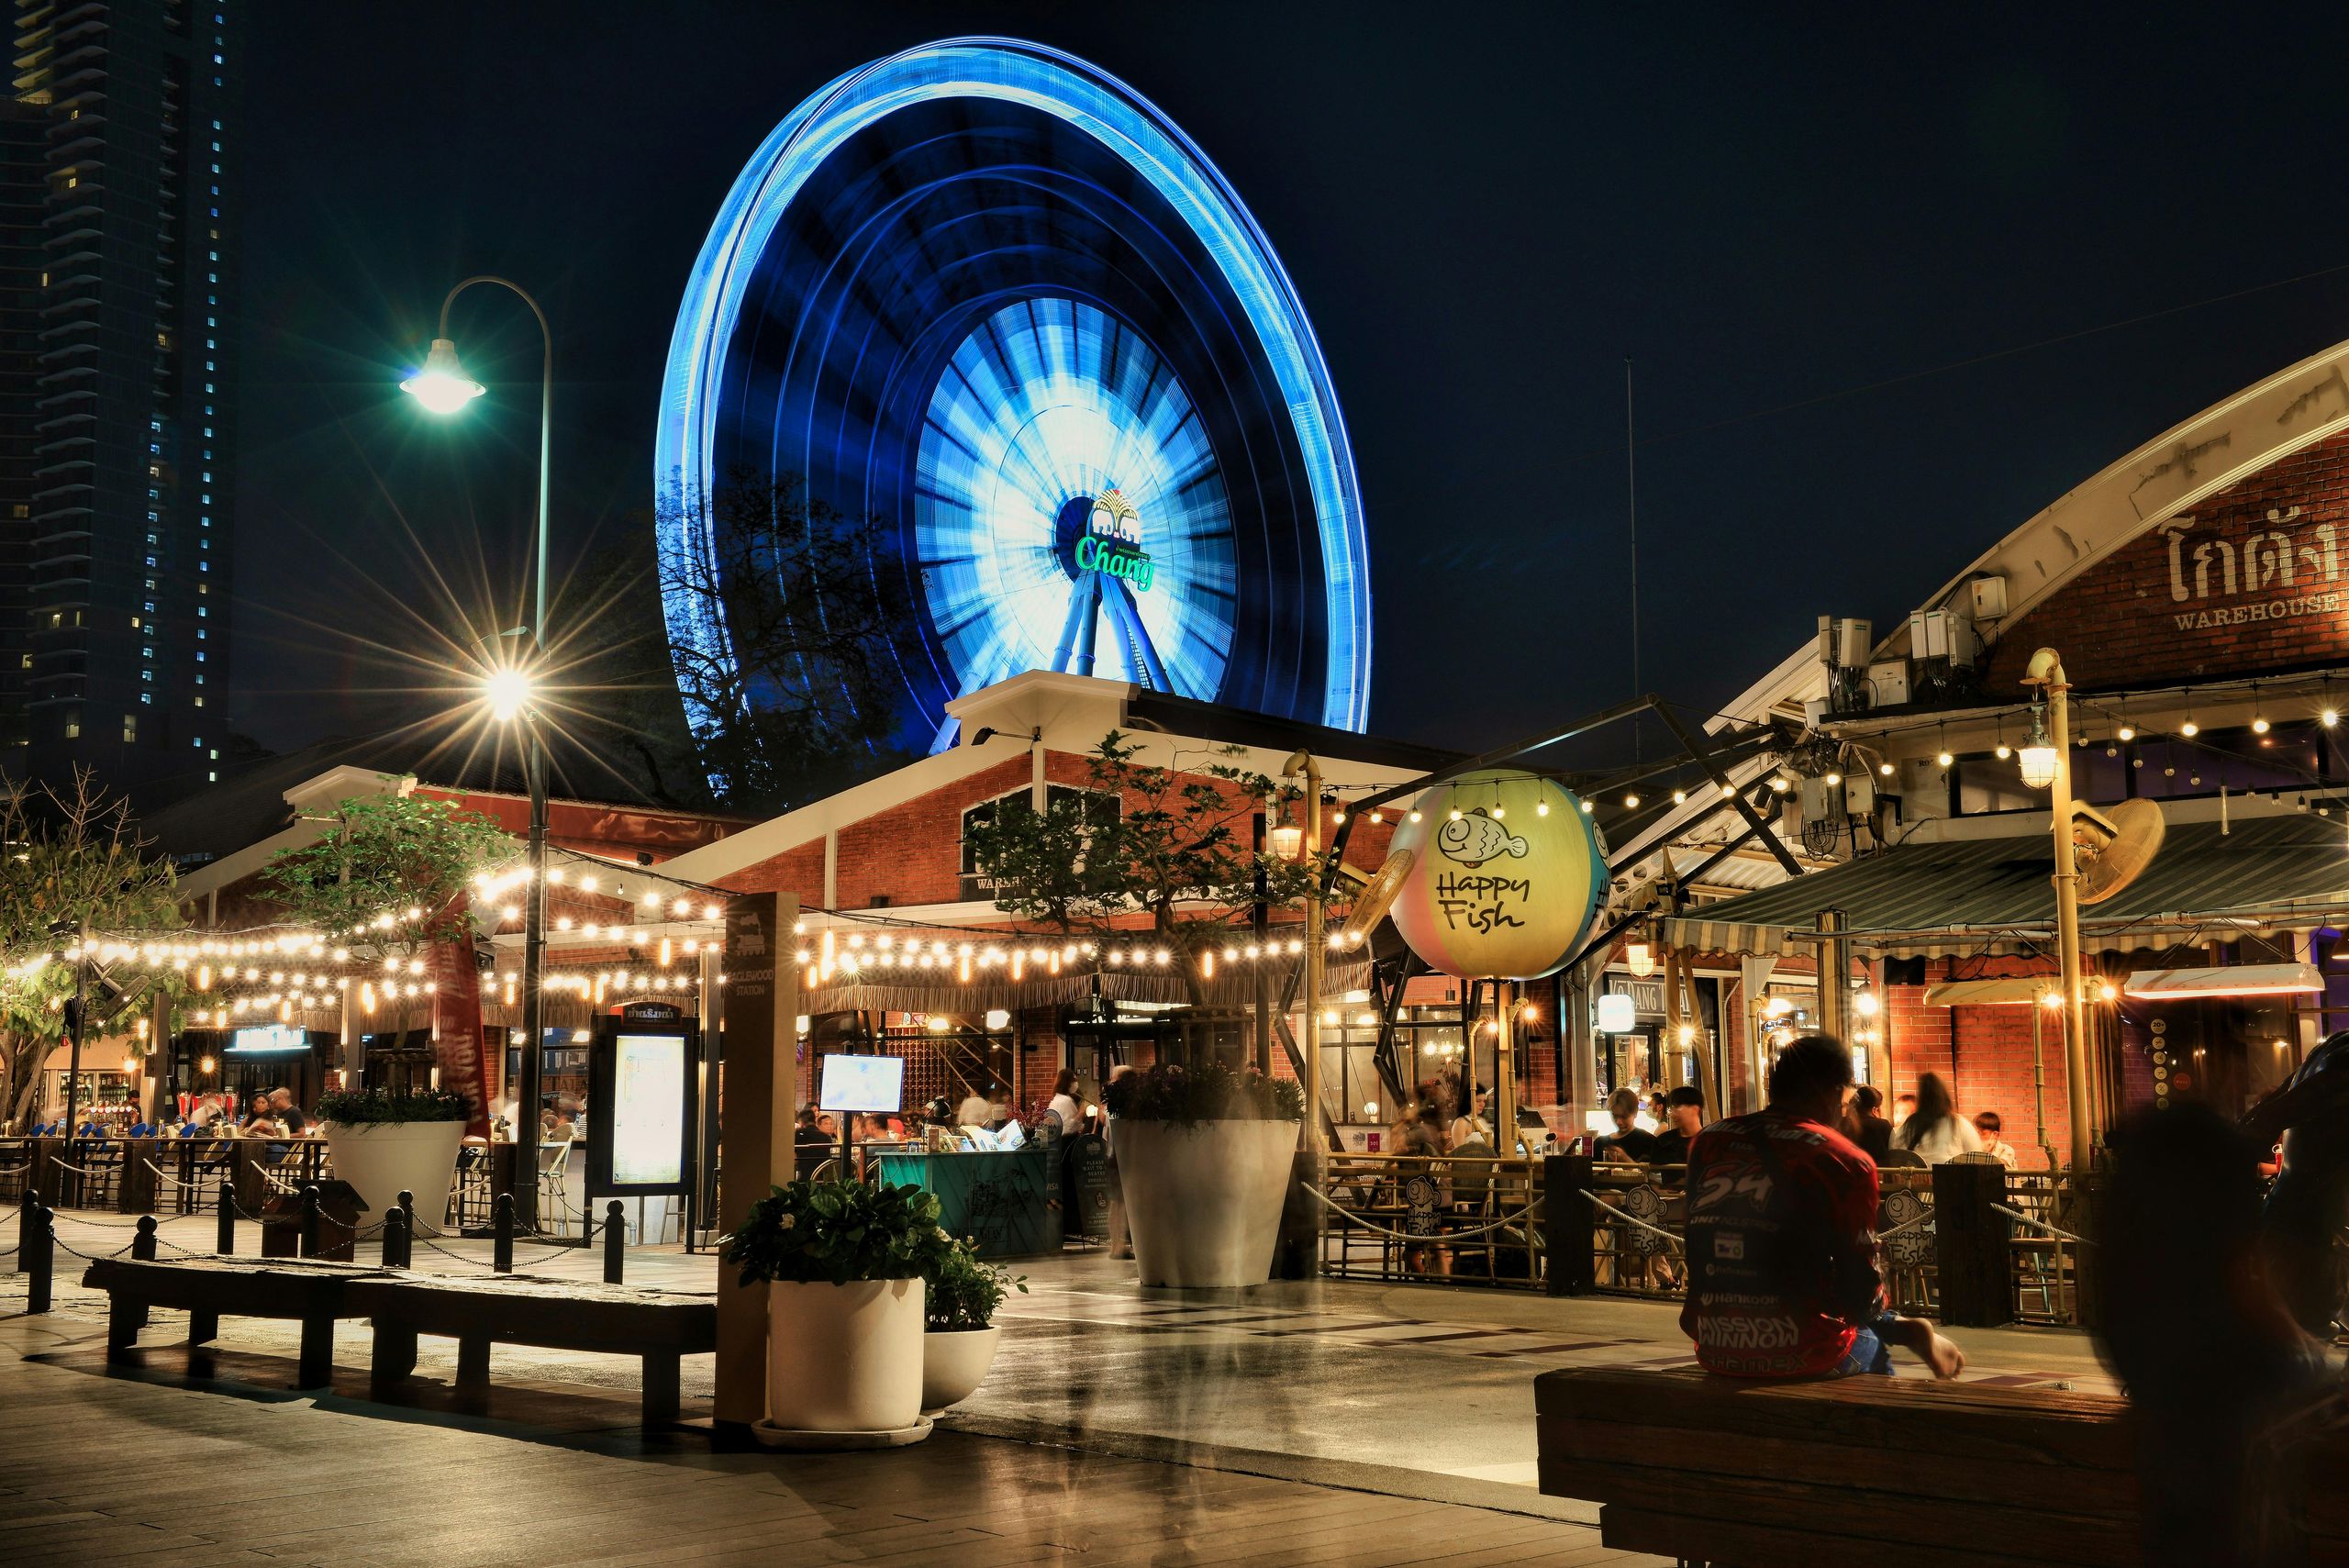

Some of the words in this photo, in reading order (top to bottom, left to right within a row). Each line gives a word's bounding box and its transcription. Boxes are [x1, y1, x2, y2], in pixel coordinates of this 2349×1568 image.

[1075, 536, 1155, 592] Chang
[2157, 506, 2339, 602] โกดัง
[2173, 594, 2341, 632] WAREHOUSE
[1436, 871, 1531, 902] Happy
[1438, 900, 1526, 935] Fish
[736, 984, 765, 996] STATION
[1408, 1209, 1441, 1225] Happy
[1629, 1233, 1669, 1254] Fish
[1888, 1244, 1934, 1265] Fish
[1697, 1315, 1798, 1334] MISSION
[1698, 1330, 1798, 1350] WINNOW
